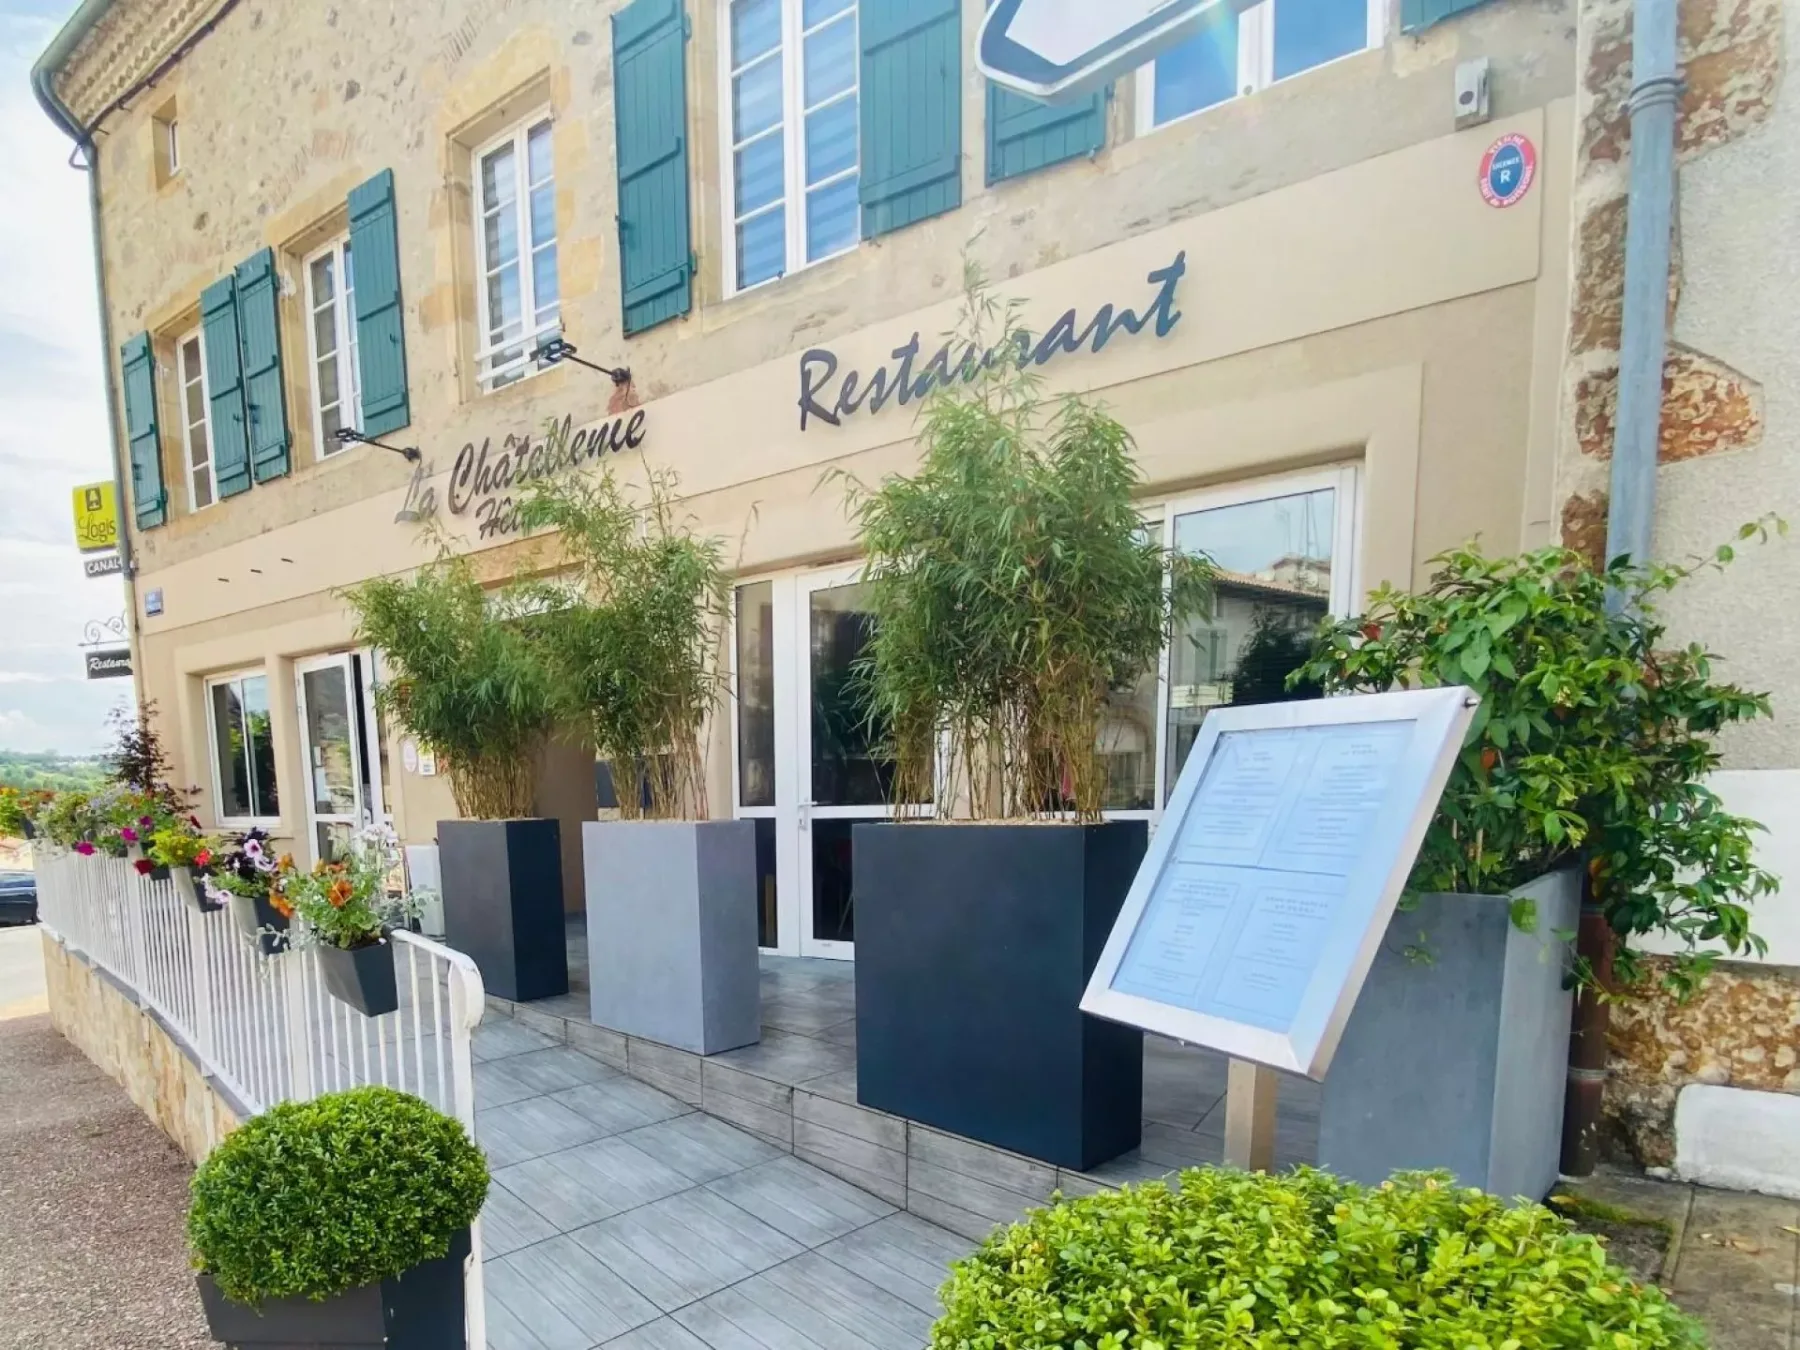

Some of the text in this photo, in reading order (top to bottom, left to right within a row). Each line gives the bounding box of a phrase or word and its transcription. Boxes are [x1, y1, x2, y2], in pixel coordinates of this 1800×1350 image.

[1500, 169, 1511, 184] R
[798, 250, 1186, 431] Restaurant
[78, 512, 116, 543] Logis
[475, 496, 543, 541] Hôt
